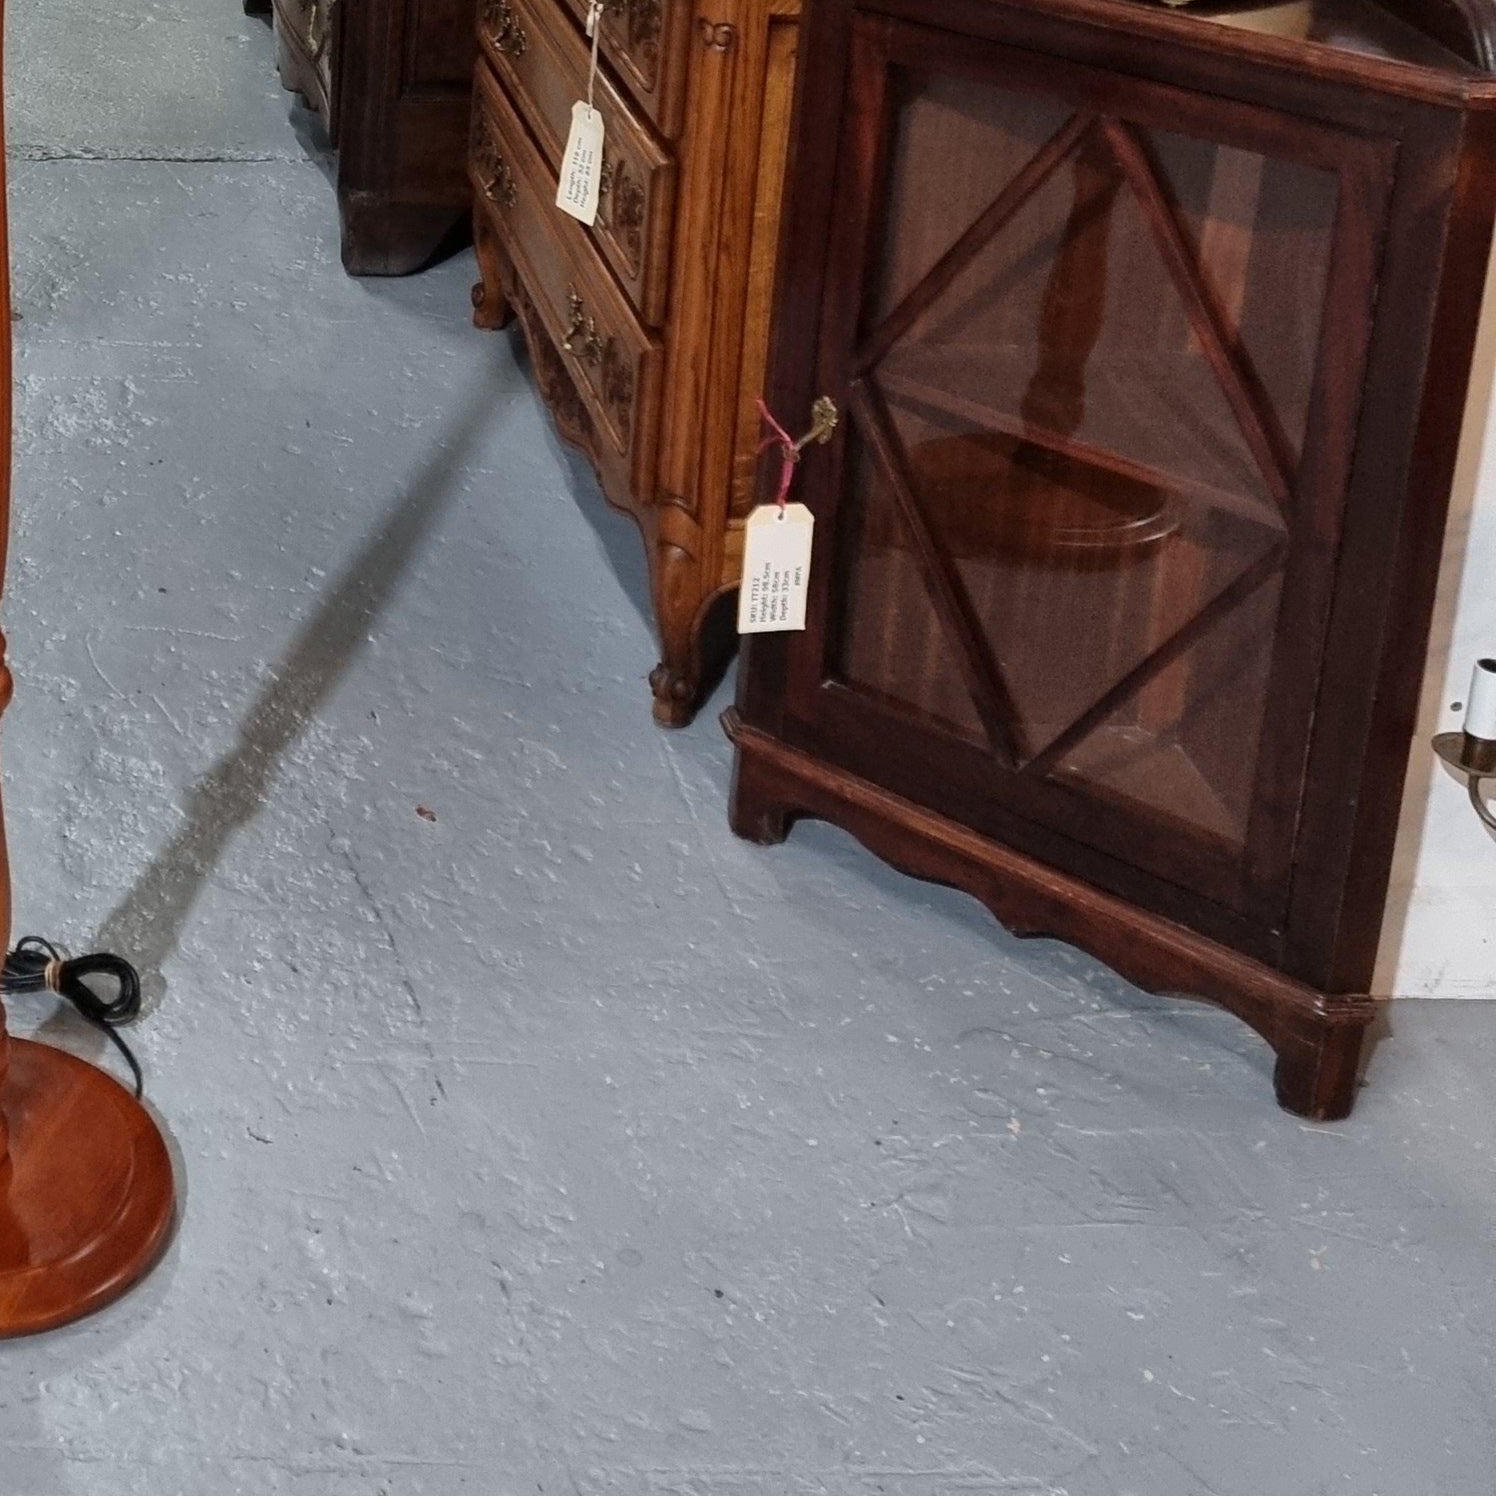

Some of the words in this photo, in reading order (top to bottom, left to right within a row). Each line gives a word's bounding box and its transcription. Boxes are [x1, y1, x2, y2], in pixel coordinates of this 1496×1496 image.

[750, 604, 758, 623] SKU:
[760, 594, 770, 623] Height:
[769, 595, 778, 622] Width:
[779, 594, 789, 621] Depth:
